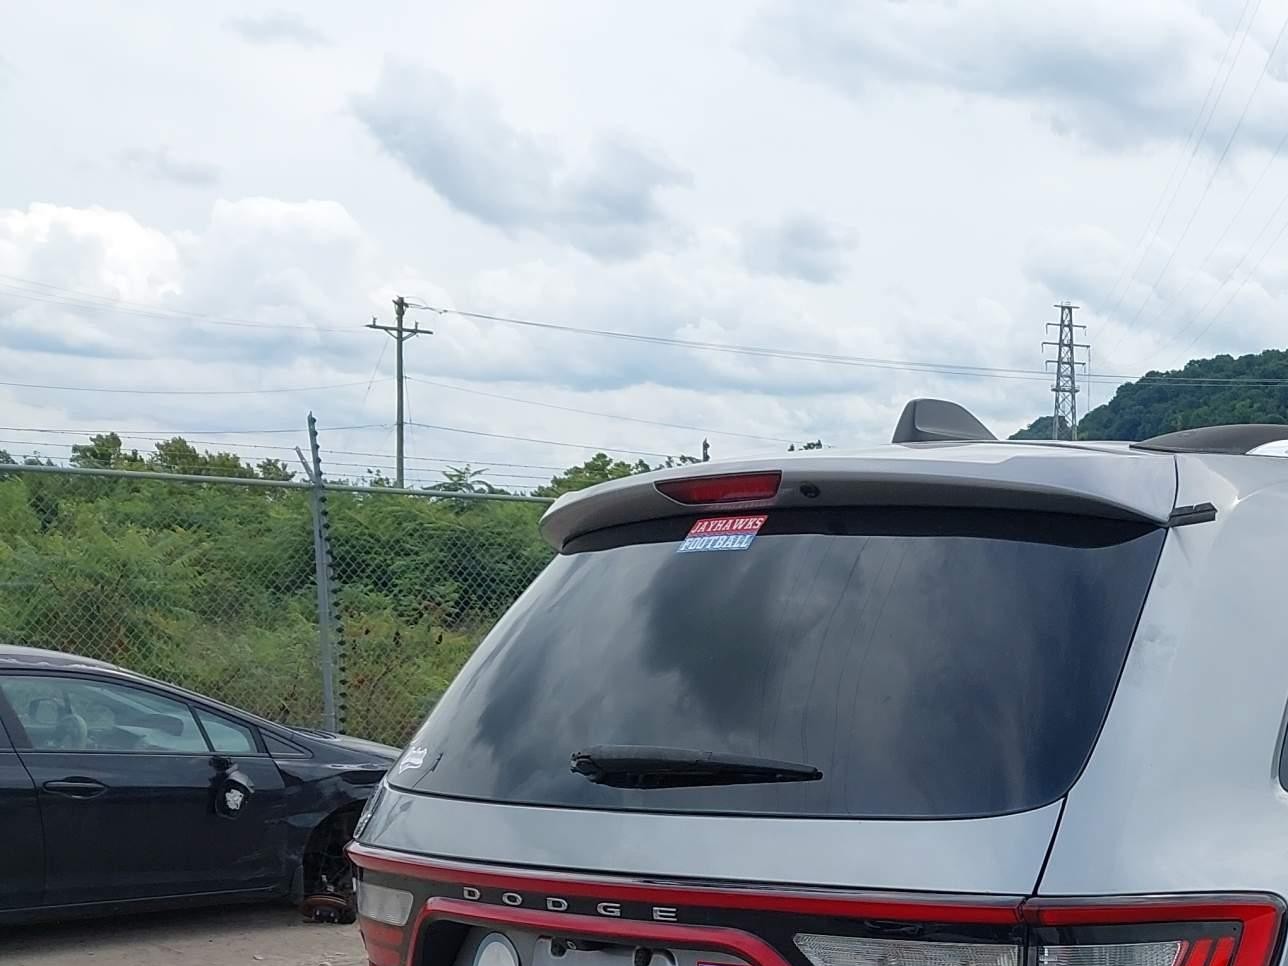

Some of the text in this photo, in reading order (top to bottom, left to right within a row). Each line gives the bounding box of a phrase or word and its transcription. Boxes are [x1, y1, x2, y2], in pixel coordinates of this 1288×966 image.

[691, 517, 764, 533] JAYHAWKS
[680, 535, 752, 551] FOOTBALL
[463, 887, 678, 921] DODGE
